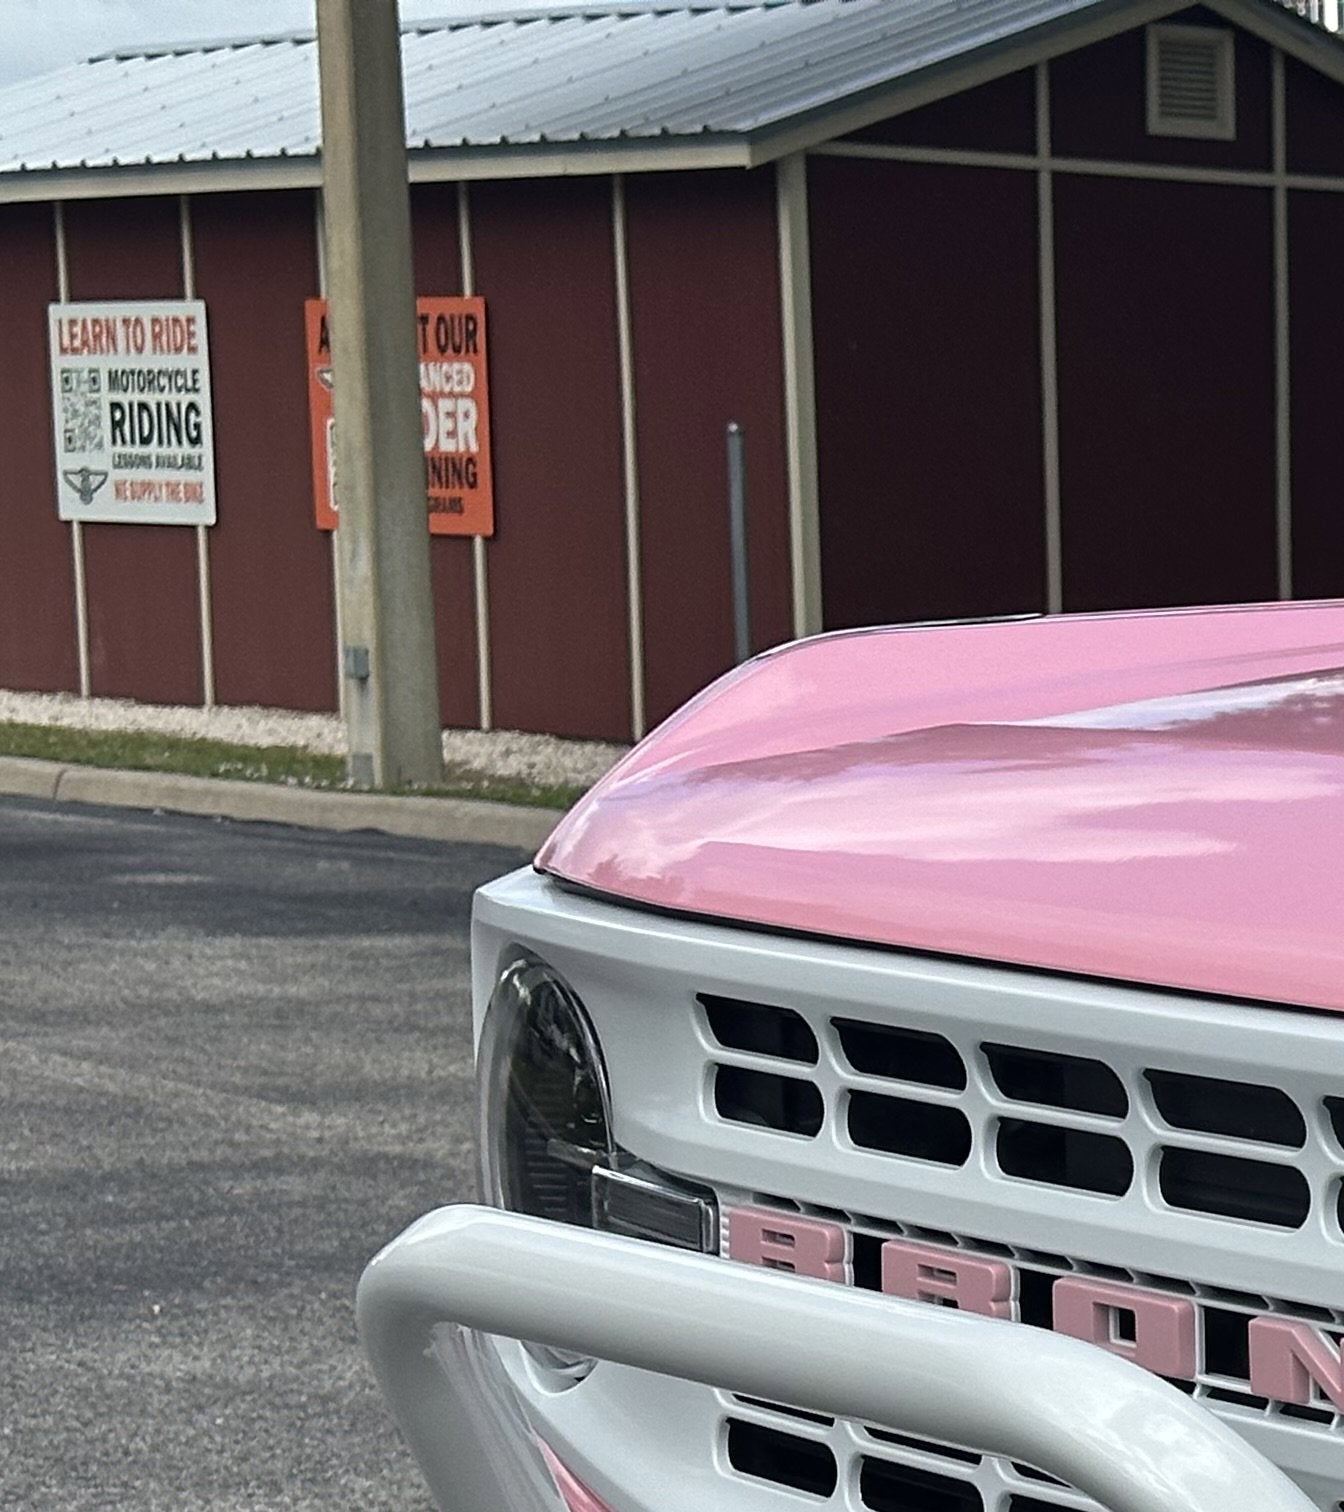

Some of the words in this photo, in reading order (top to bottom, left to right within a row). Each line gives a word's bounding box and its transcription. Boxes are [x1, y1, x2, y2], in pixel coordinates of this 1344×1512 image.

[58, 317, 117, 355] LEARN
[121, 317, 145, 355] TO
[151, 315, 198, 355] RIDE
[436, 313, 478, 355] OUR
[108, 368, 200, 393] MOTORCYCLE
[109, 401, 203, 447] RIDING
[421, 397, 479, 453] DER
